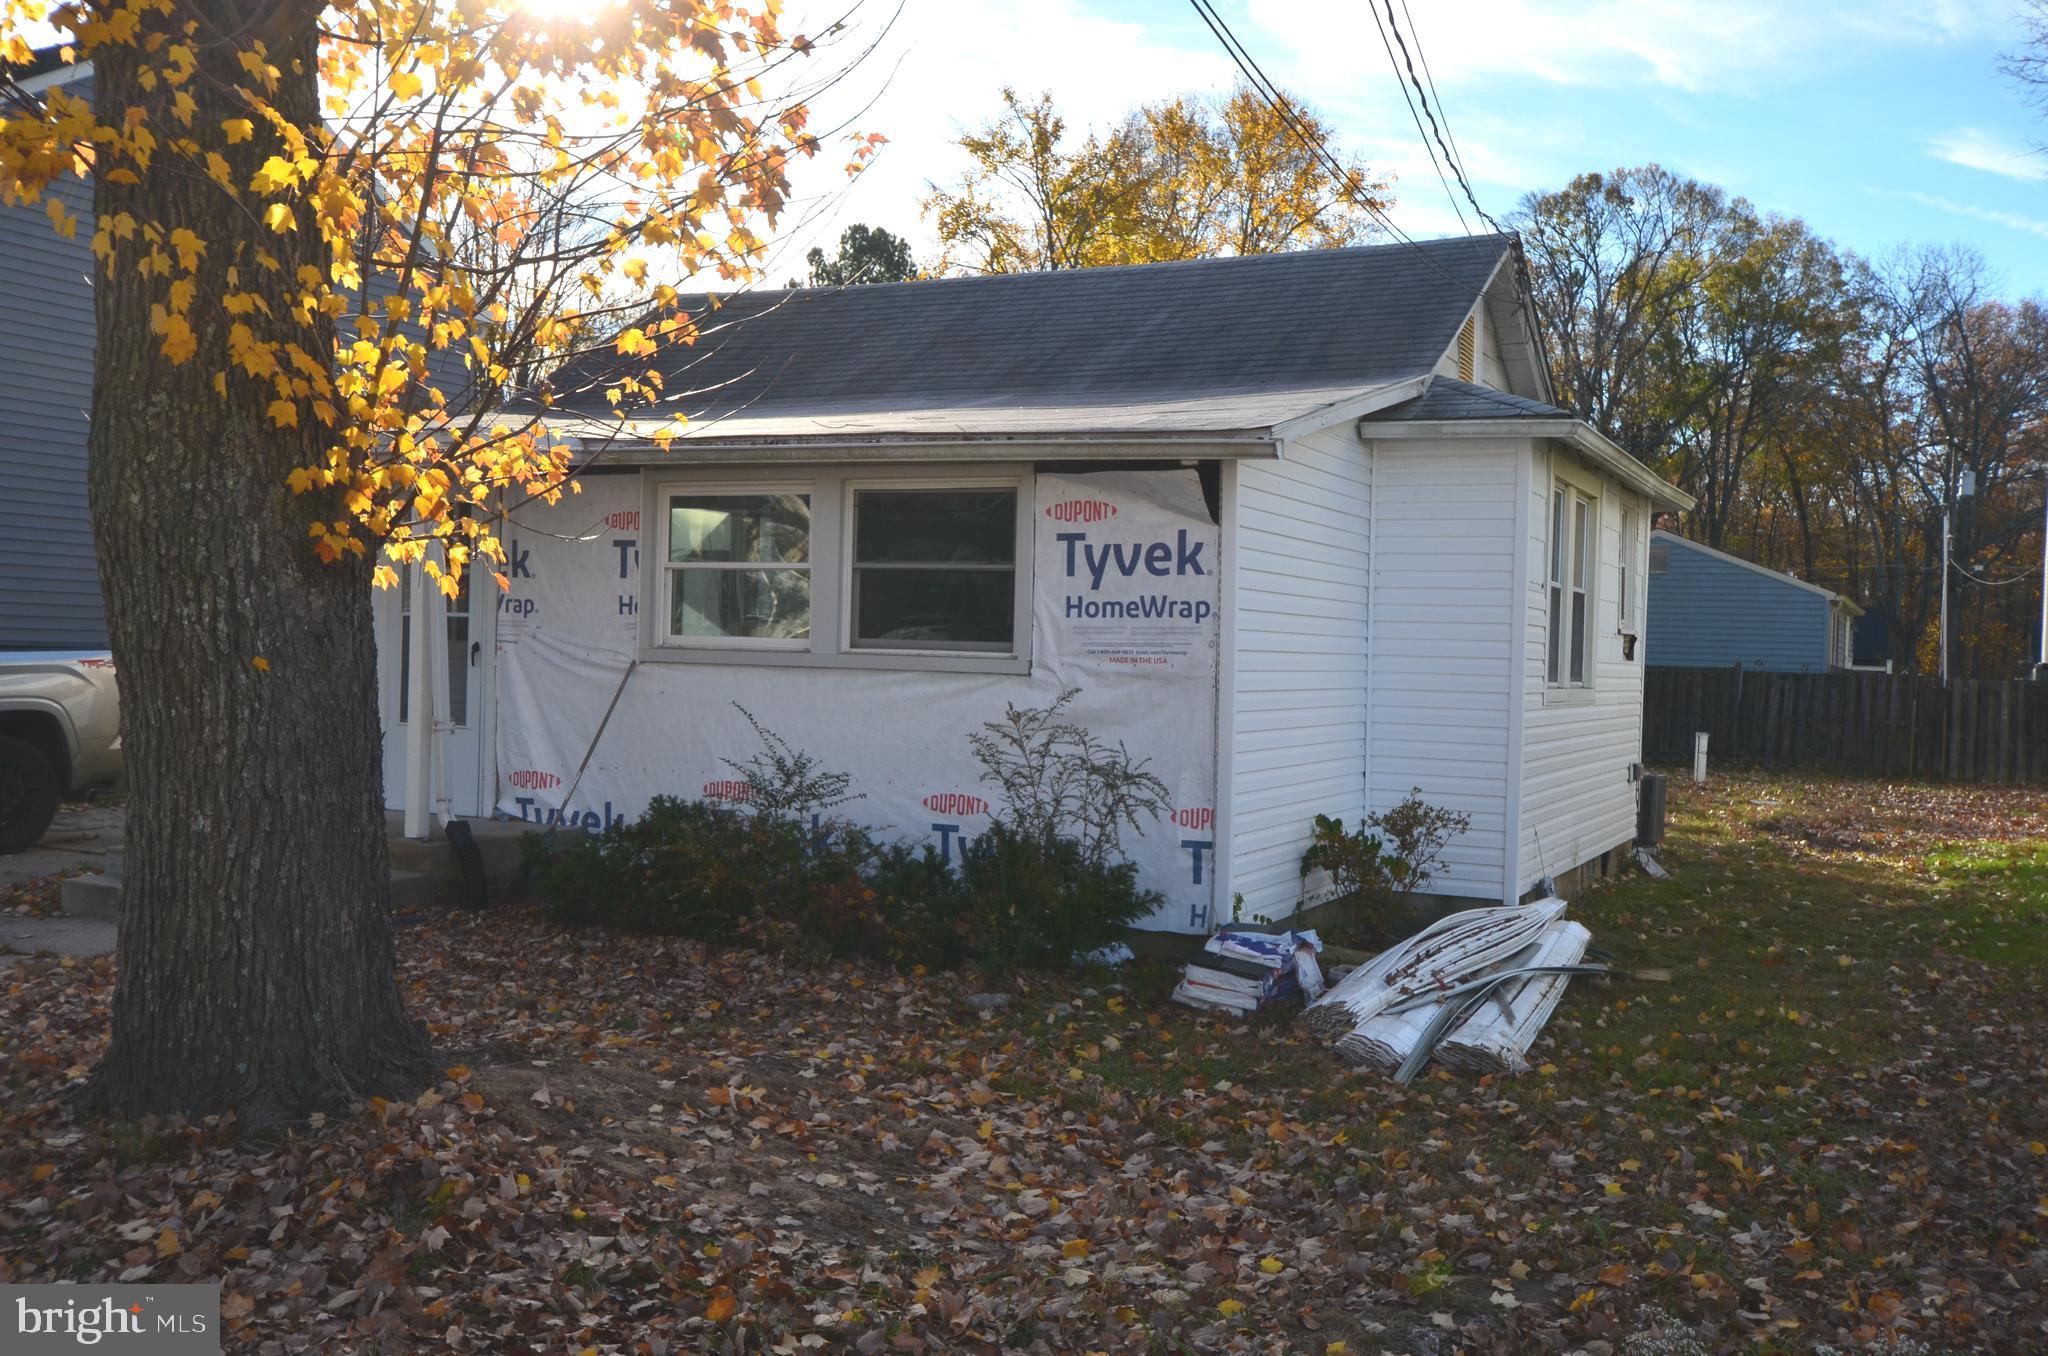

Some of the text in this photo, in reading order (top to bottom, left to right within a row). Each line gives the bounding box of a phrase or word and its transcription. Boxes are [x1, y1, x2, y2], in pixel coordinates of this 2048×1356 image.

[1054, 500, 1110, 523] DUPONT
[1056, 529, 1205, 590] Tyvek
[1065, 595, 1211, 624] HomeWrap
[1109, 656, 1129, 664] MADE
[1153, 657, 1168, 665] USA
[512, 770, 555, 790] DUPONT
[930, 793, 982, 815] DUPONT
